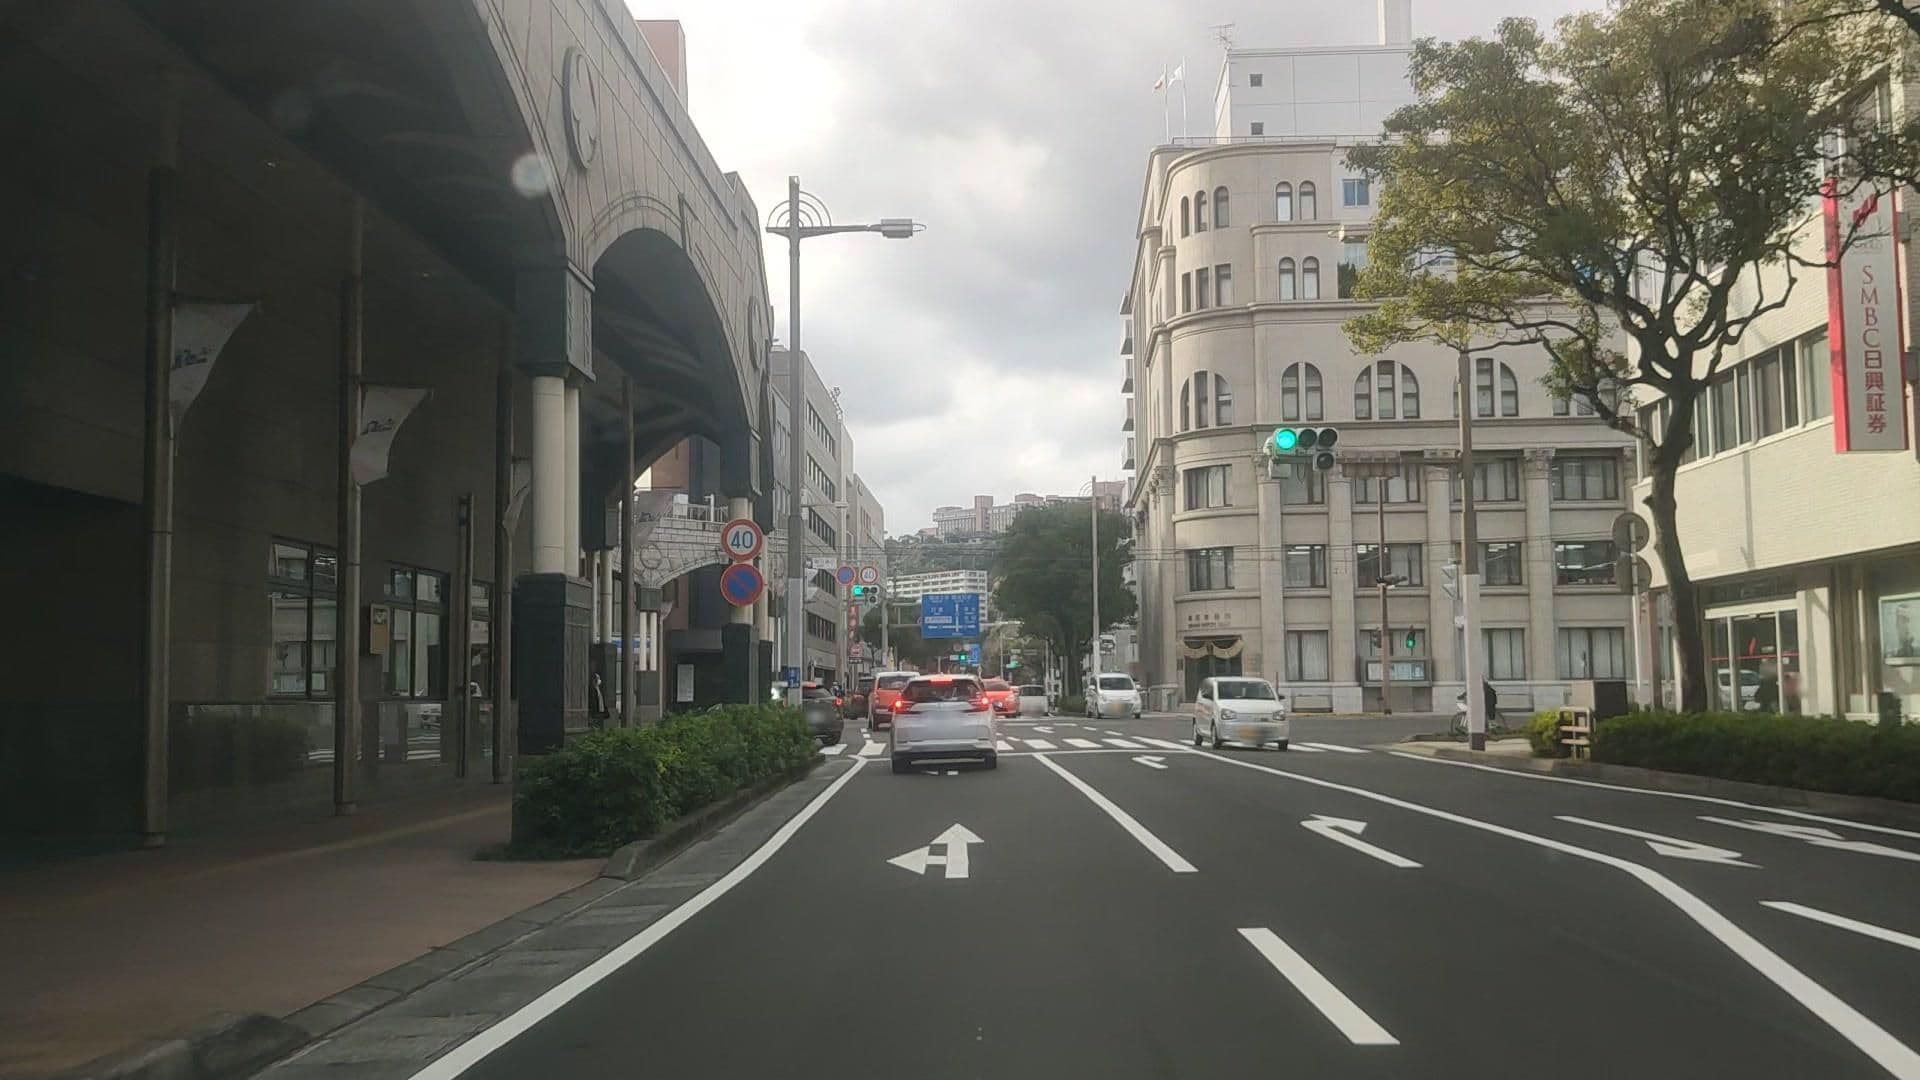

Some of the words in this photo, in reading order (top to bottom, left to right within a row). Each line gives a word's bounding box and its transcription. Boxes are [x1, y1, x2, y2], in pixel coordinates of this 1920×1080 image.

[1860, 265, 1887, 434] SMBC日興証券
[731, 530, 753, 549] 40
[863, 570, 874, 579] 40
